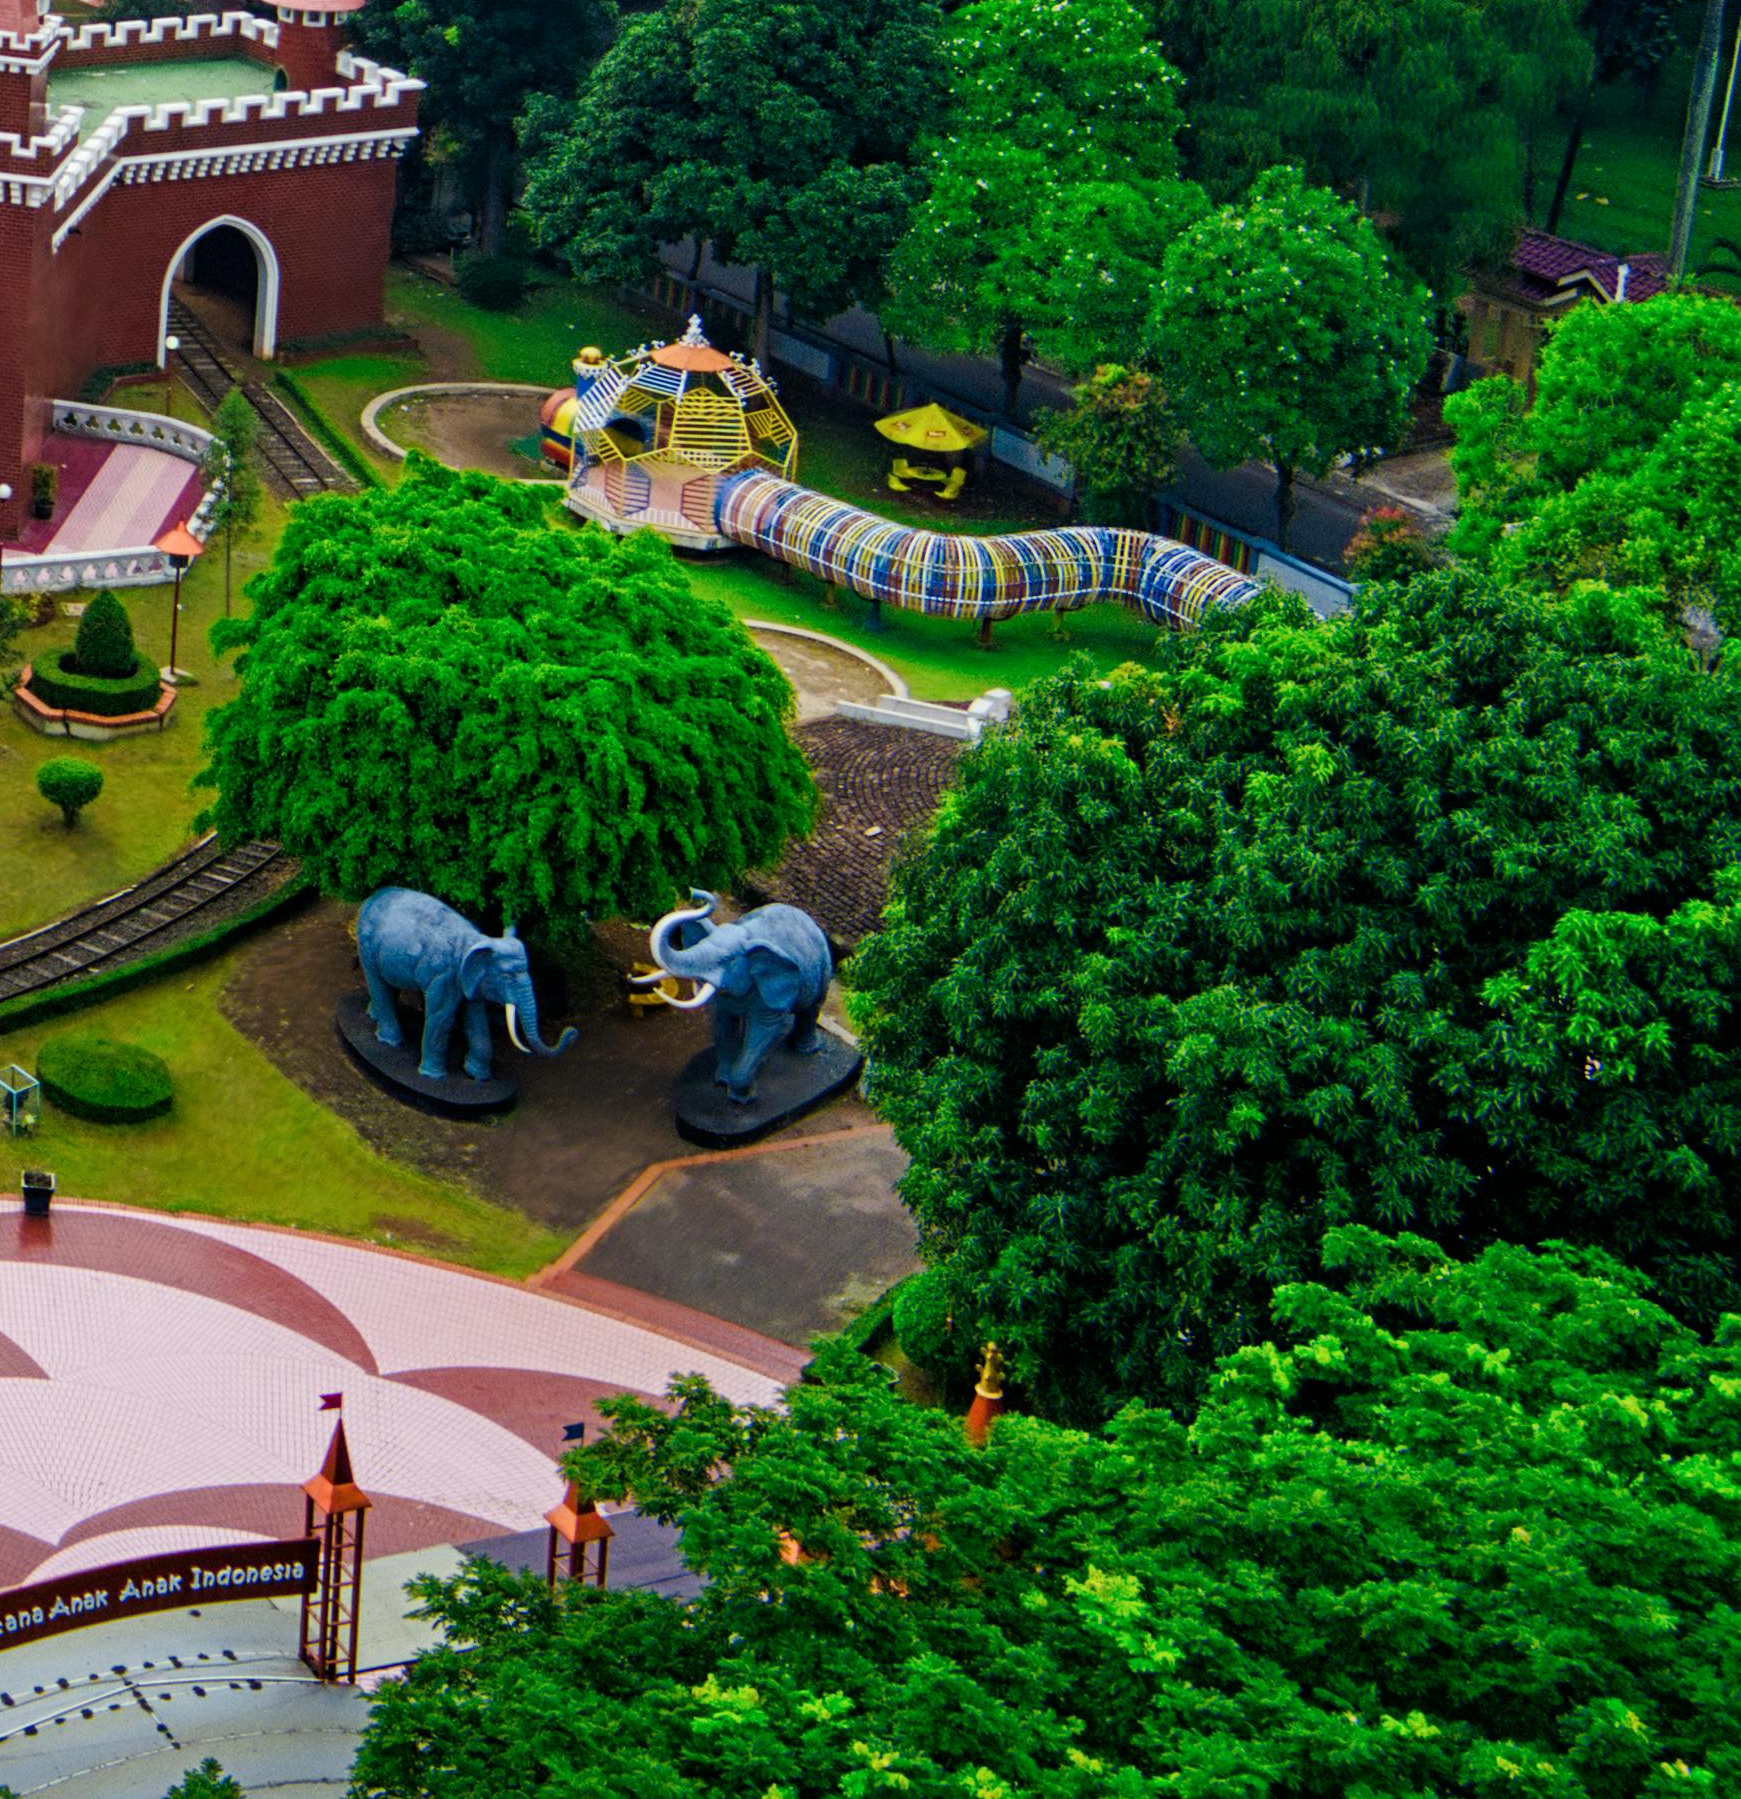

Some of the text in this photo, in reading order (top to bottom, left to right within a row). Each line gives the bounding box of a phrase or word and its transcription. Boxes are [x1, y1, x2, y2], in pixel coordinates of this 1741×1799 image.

[48, 1588, 110, 1620] Anak
[119, 1573, 183, 1603] Anak
[190, 1561, 305, 1590] Indonesia
